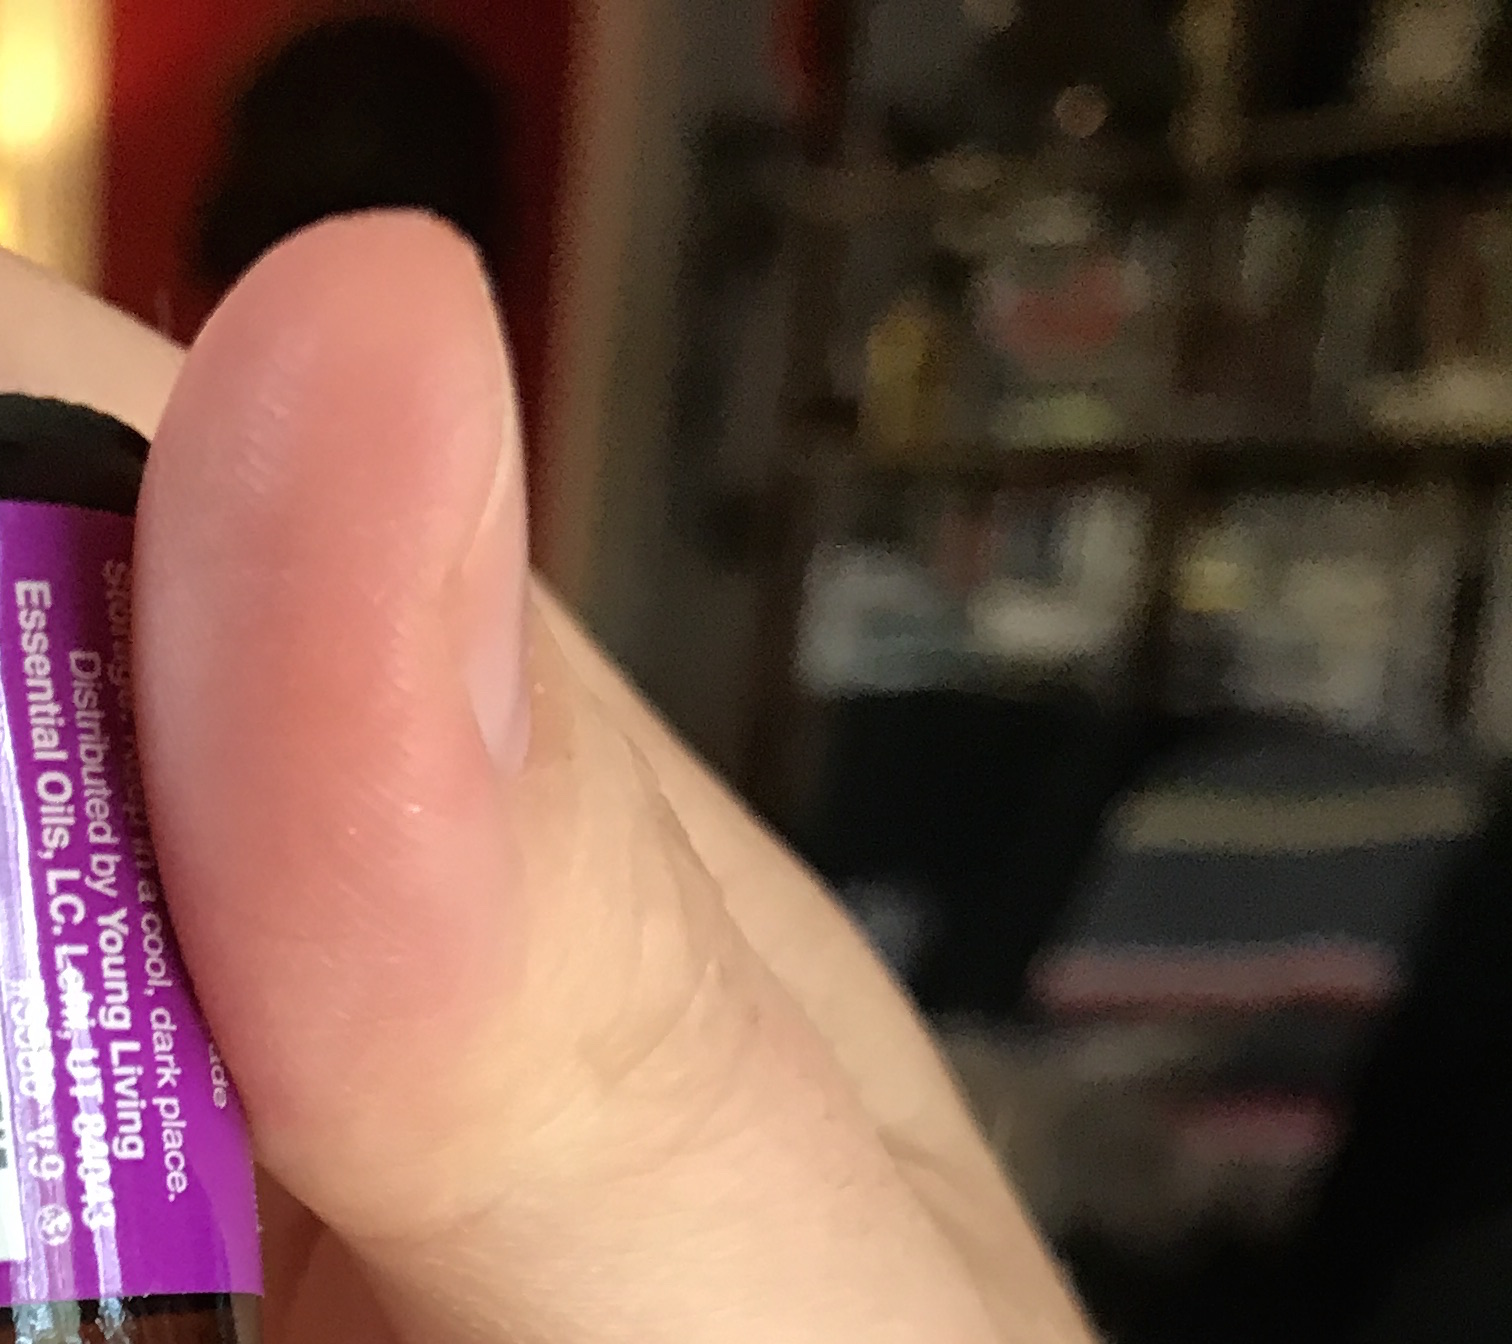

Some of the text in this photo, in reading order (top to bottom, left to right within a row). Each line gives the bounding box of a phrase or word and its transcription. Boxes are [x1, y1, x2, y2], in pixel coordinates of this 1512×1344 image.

[15, 579, 69, 762] Essential
[36, 771, 77, 861] Oils,
[46, 869, 87, 936] LC.
[69, 648, 147, 1161] Distributed by Young Living
[138, 877, 159, 903] a
[141, 912, 174, 997] cool,
[65, 1048, 105, 1106] UT
[150, 1006, 183, 1089] dark
[152, 1096, 189, 1203] place.
